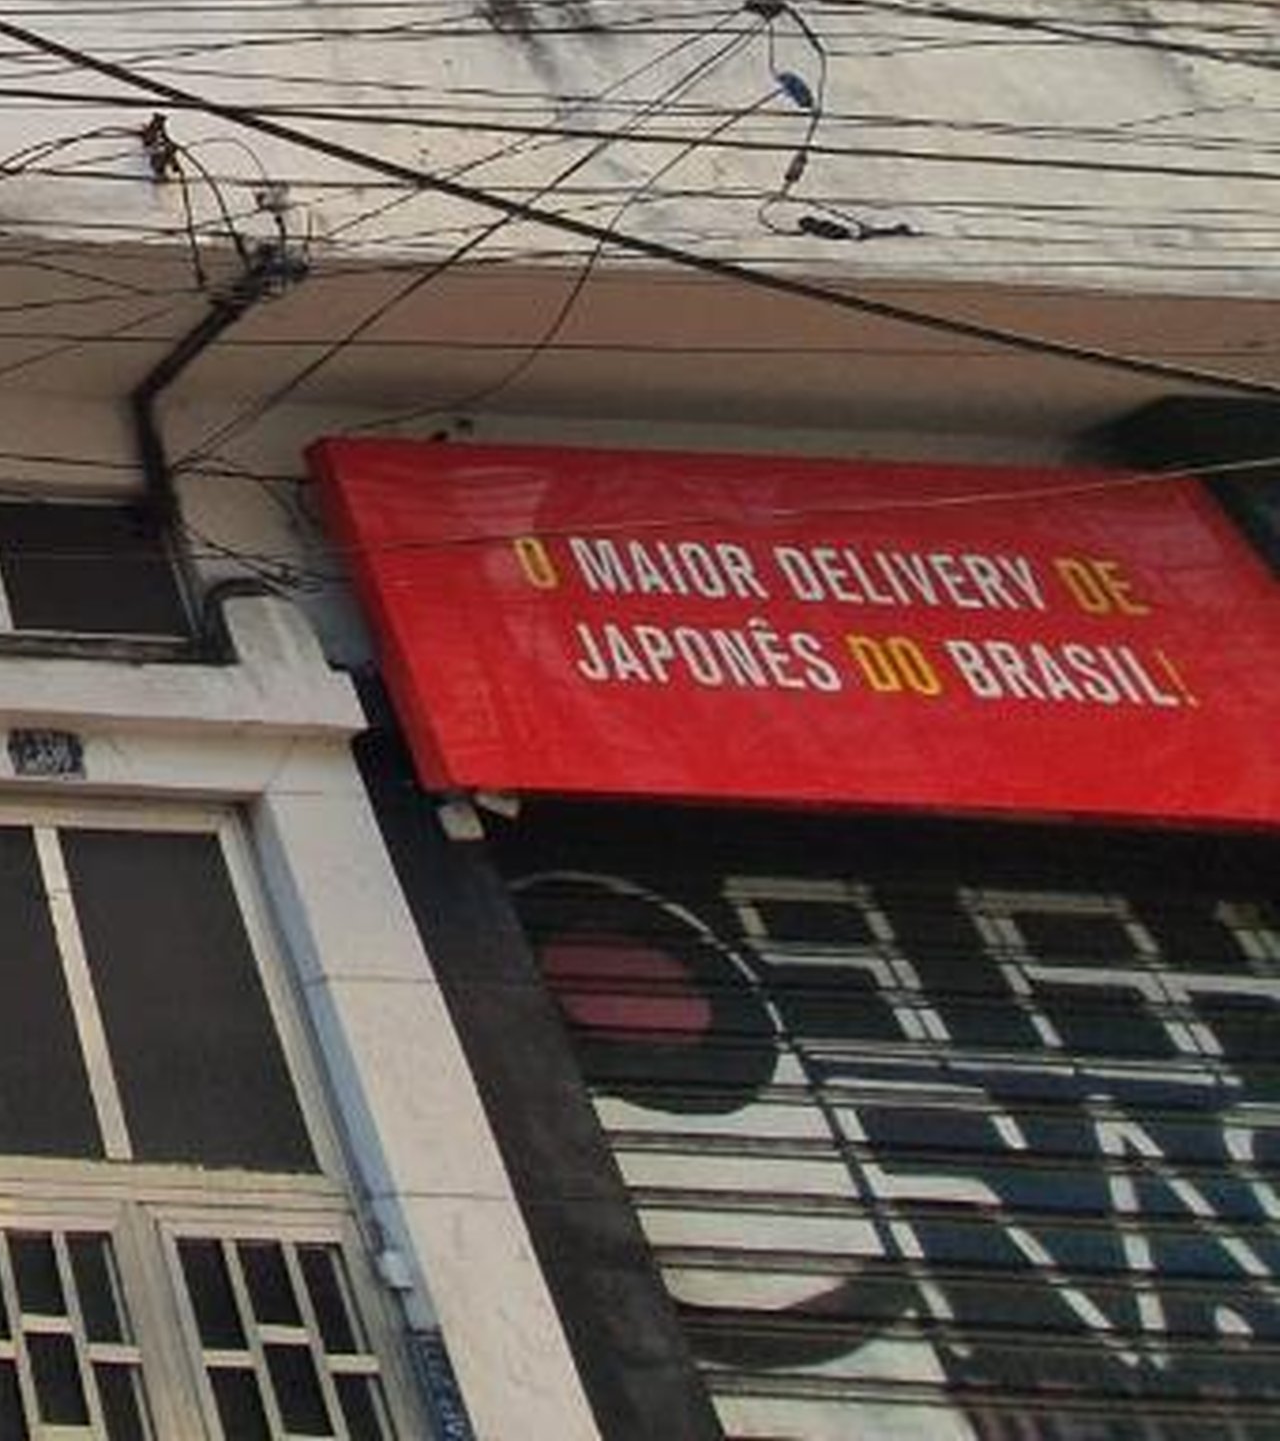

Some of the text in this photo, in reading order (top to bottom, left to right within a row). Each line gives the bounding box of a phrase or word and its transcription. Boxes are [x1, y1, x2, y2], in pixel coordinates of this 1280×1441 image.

[514, 536, 1151, 616] O MAIOR DELIVERY DE
[575, 616, 1199, 708] JAPONÊS DO BRASIL!
